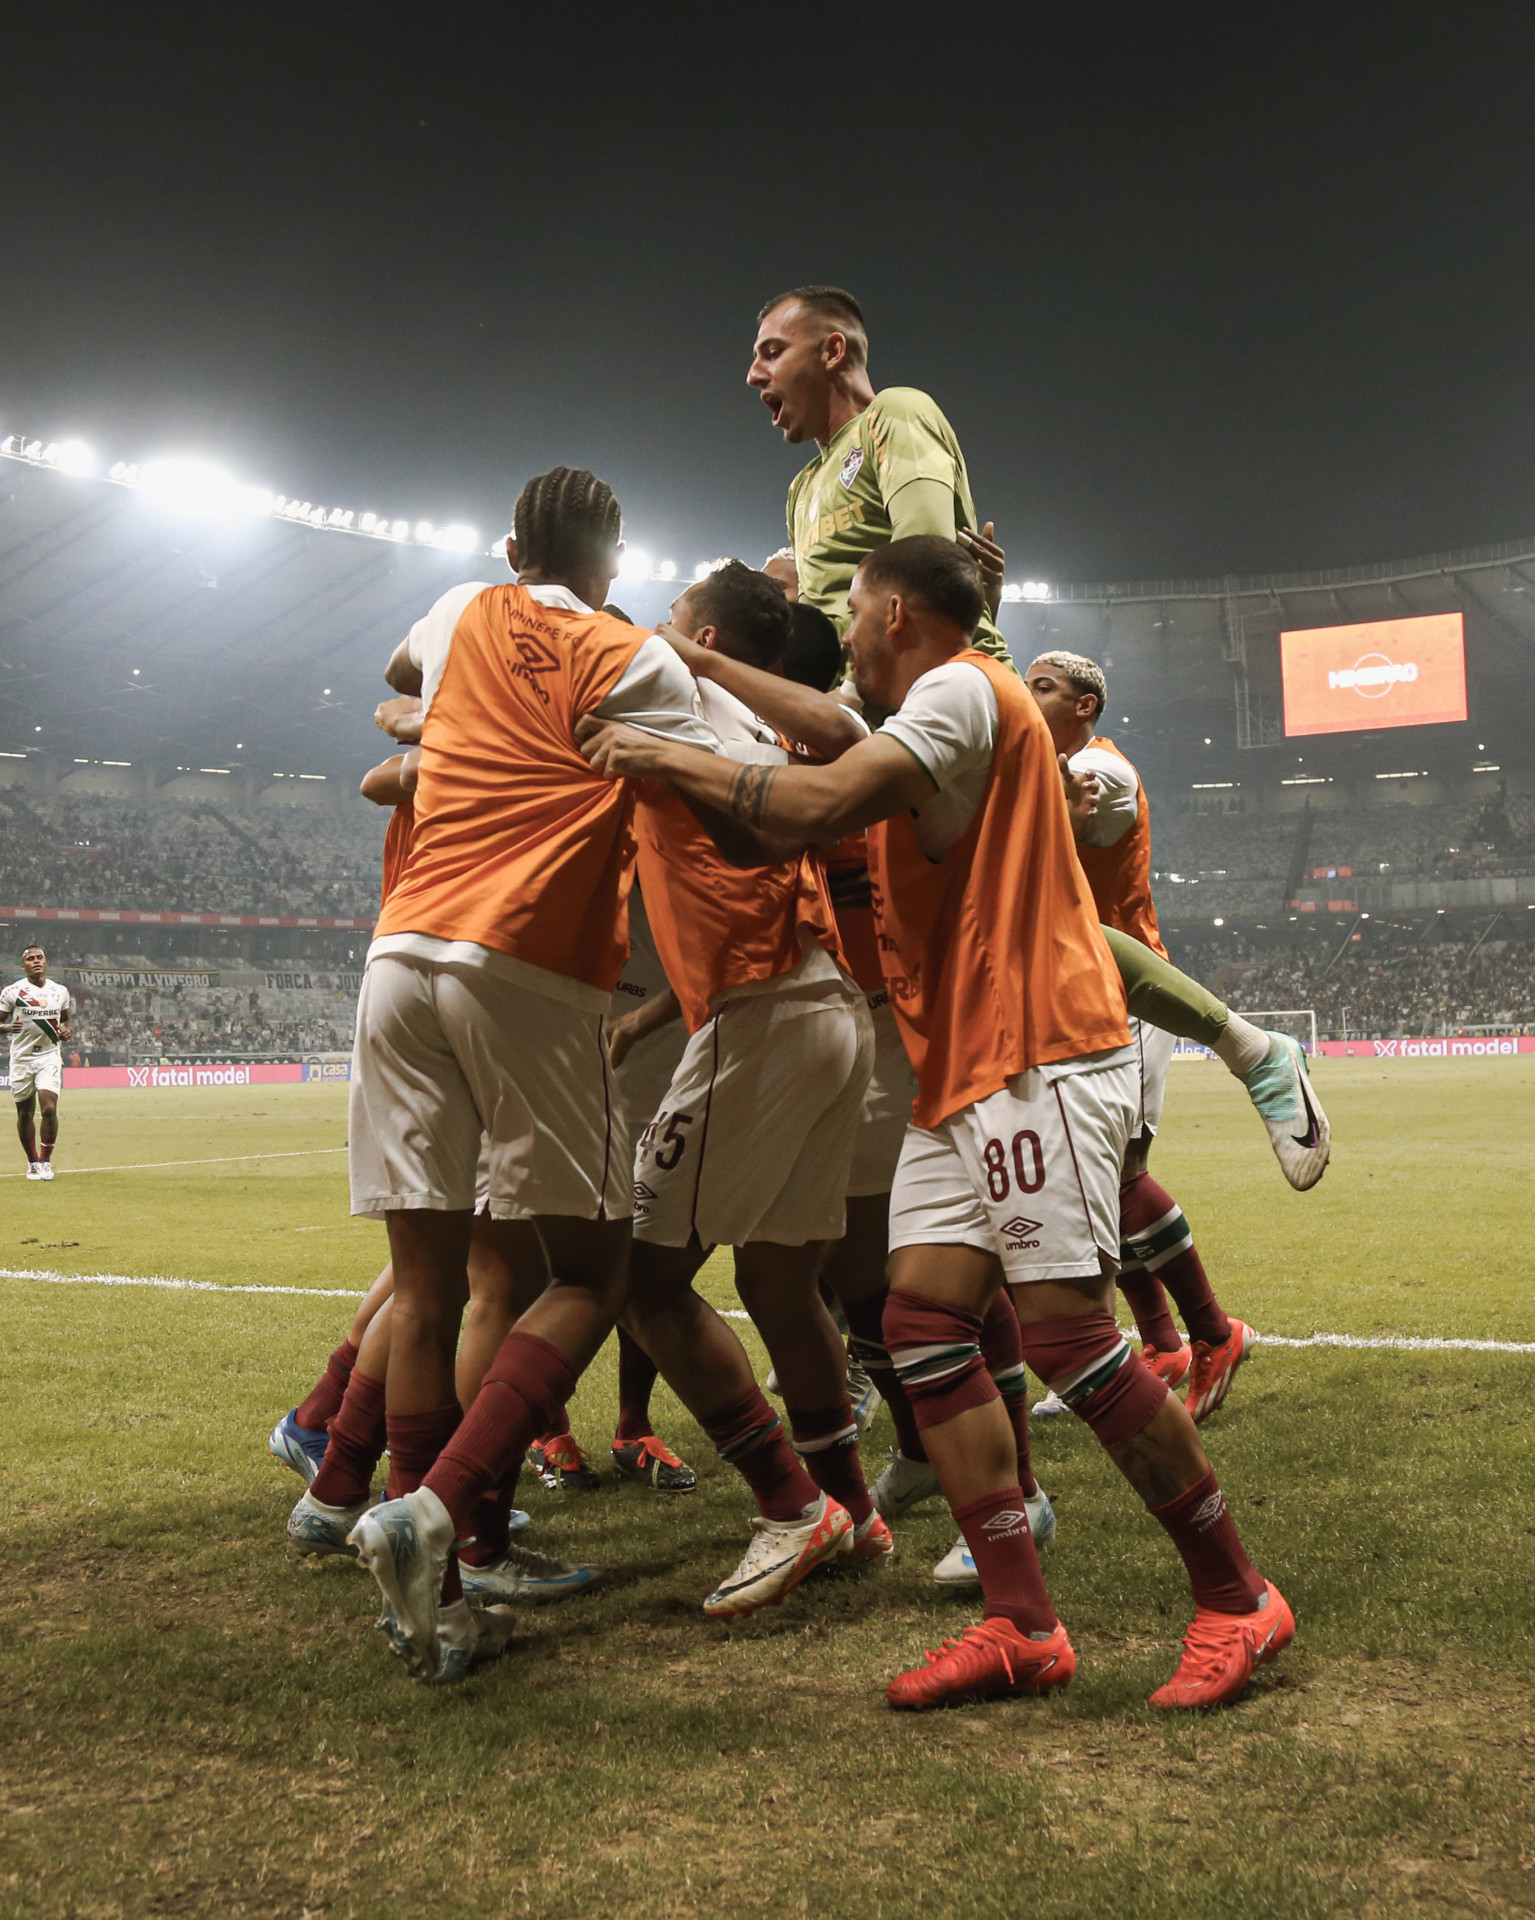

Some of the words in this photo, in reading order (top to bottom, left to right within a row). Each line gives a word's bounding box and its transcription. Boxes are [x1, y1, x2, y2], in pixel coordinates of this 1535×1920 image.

[1400, 1040, 1447, 1056] fatal
[1452, 1038, 1518, 1055] model
[152, 1067, 193, 1086] fatal
[197, 1066, 250, 1085] model
[323, 1064, 348, 1076] casa
[984, 1129, 1046, 1202] 80
[1005, 1239, 1040, 1251] umbro
[988, 1525, 1028, 1542] umbro
